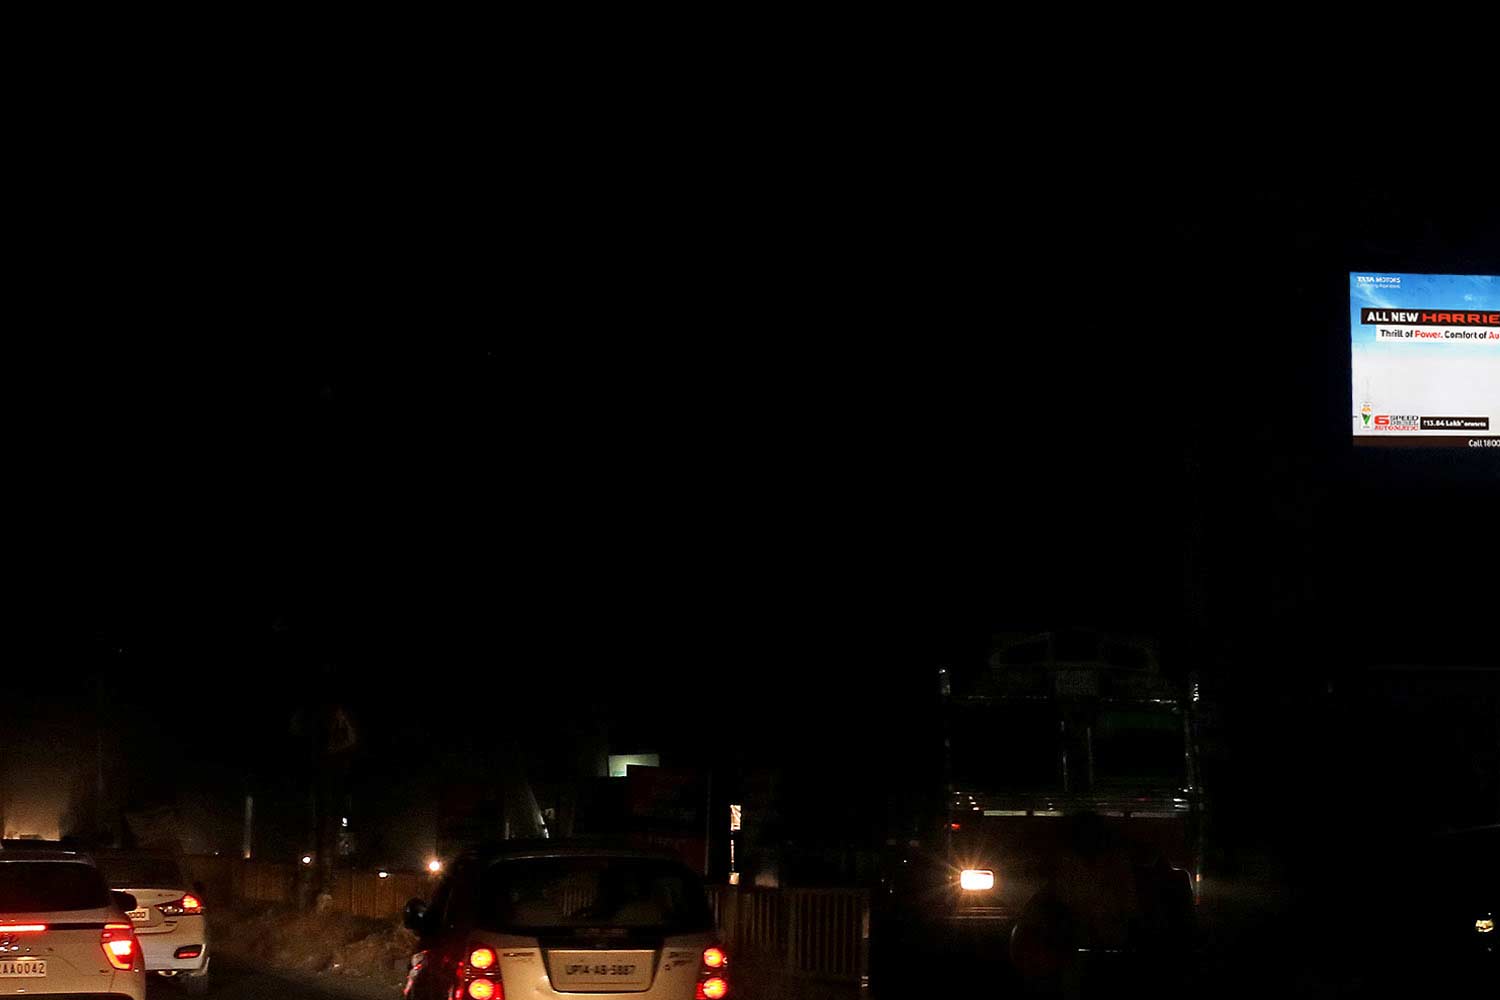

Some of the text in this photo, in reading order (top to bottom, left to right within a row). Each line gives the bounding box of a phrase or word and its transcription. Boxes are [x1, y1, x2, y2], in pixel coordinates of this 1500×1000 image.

[1367, 311, 1389, 322] ALL
[1391, 311, 1419, 323] NEW
[1380, 329, 1404, 338] Thrill
[1405, 329, 1414, 338] of
[1415, 330, 1443, 339] Power.
[1445, 330, 1477, 340] Comfort
[1478, 330, 1488, 340] of
[1374, 415, 1390, 425] 6
[1468, 439, 1482, 447] Call
